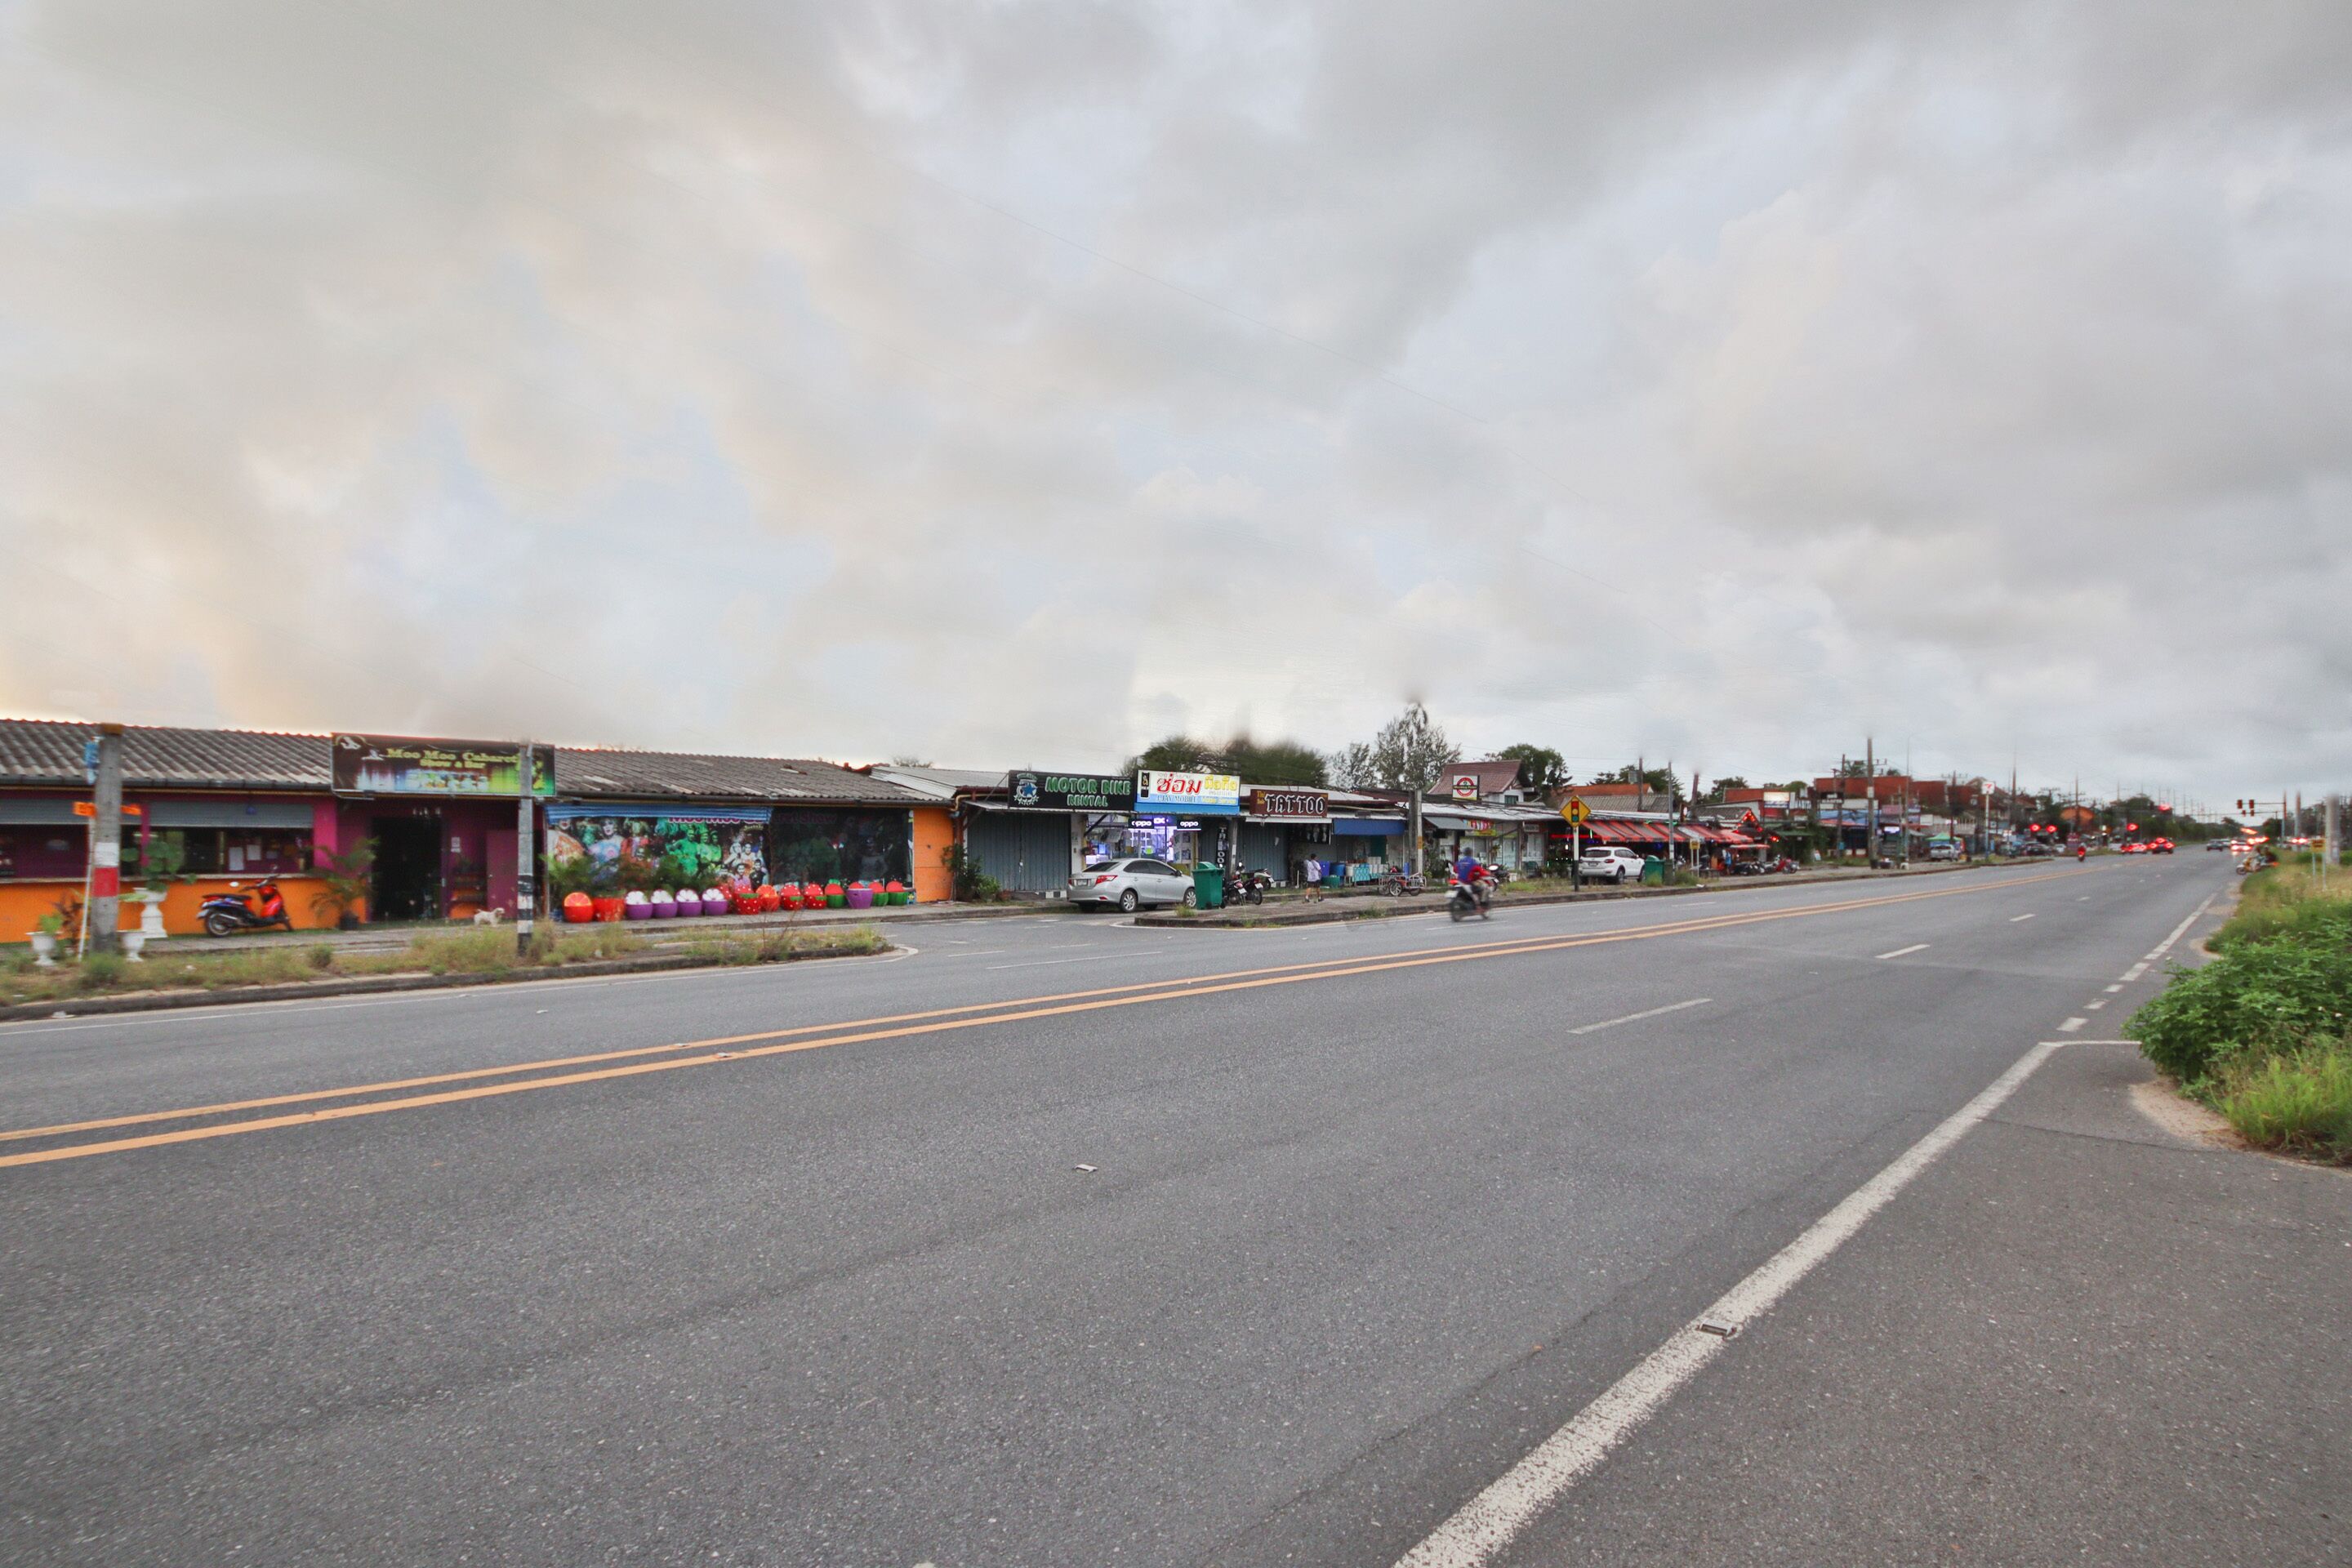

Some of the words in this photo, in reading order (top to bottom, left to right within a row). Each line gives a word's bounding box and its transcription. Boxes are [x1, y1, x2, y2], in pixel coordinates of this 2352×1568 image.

[386, 748, 421, 759] Moo
[423, 749, 456, 760] Moo
[1045, 777, 1098, 794] MOTOR
[1101, 779, 1131, 795] BIKE
[1067, 794, 1108, 807] RENTAL
[1264, 794, 1325, 814] TATTOO
[1217, 826, 1227, 864] TAOO
